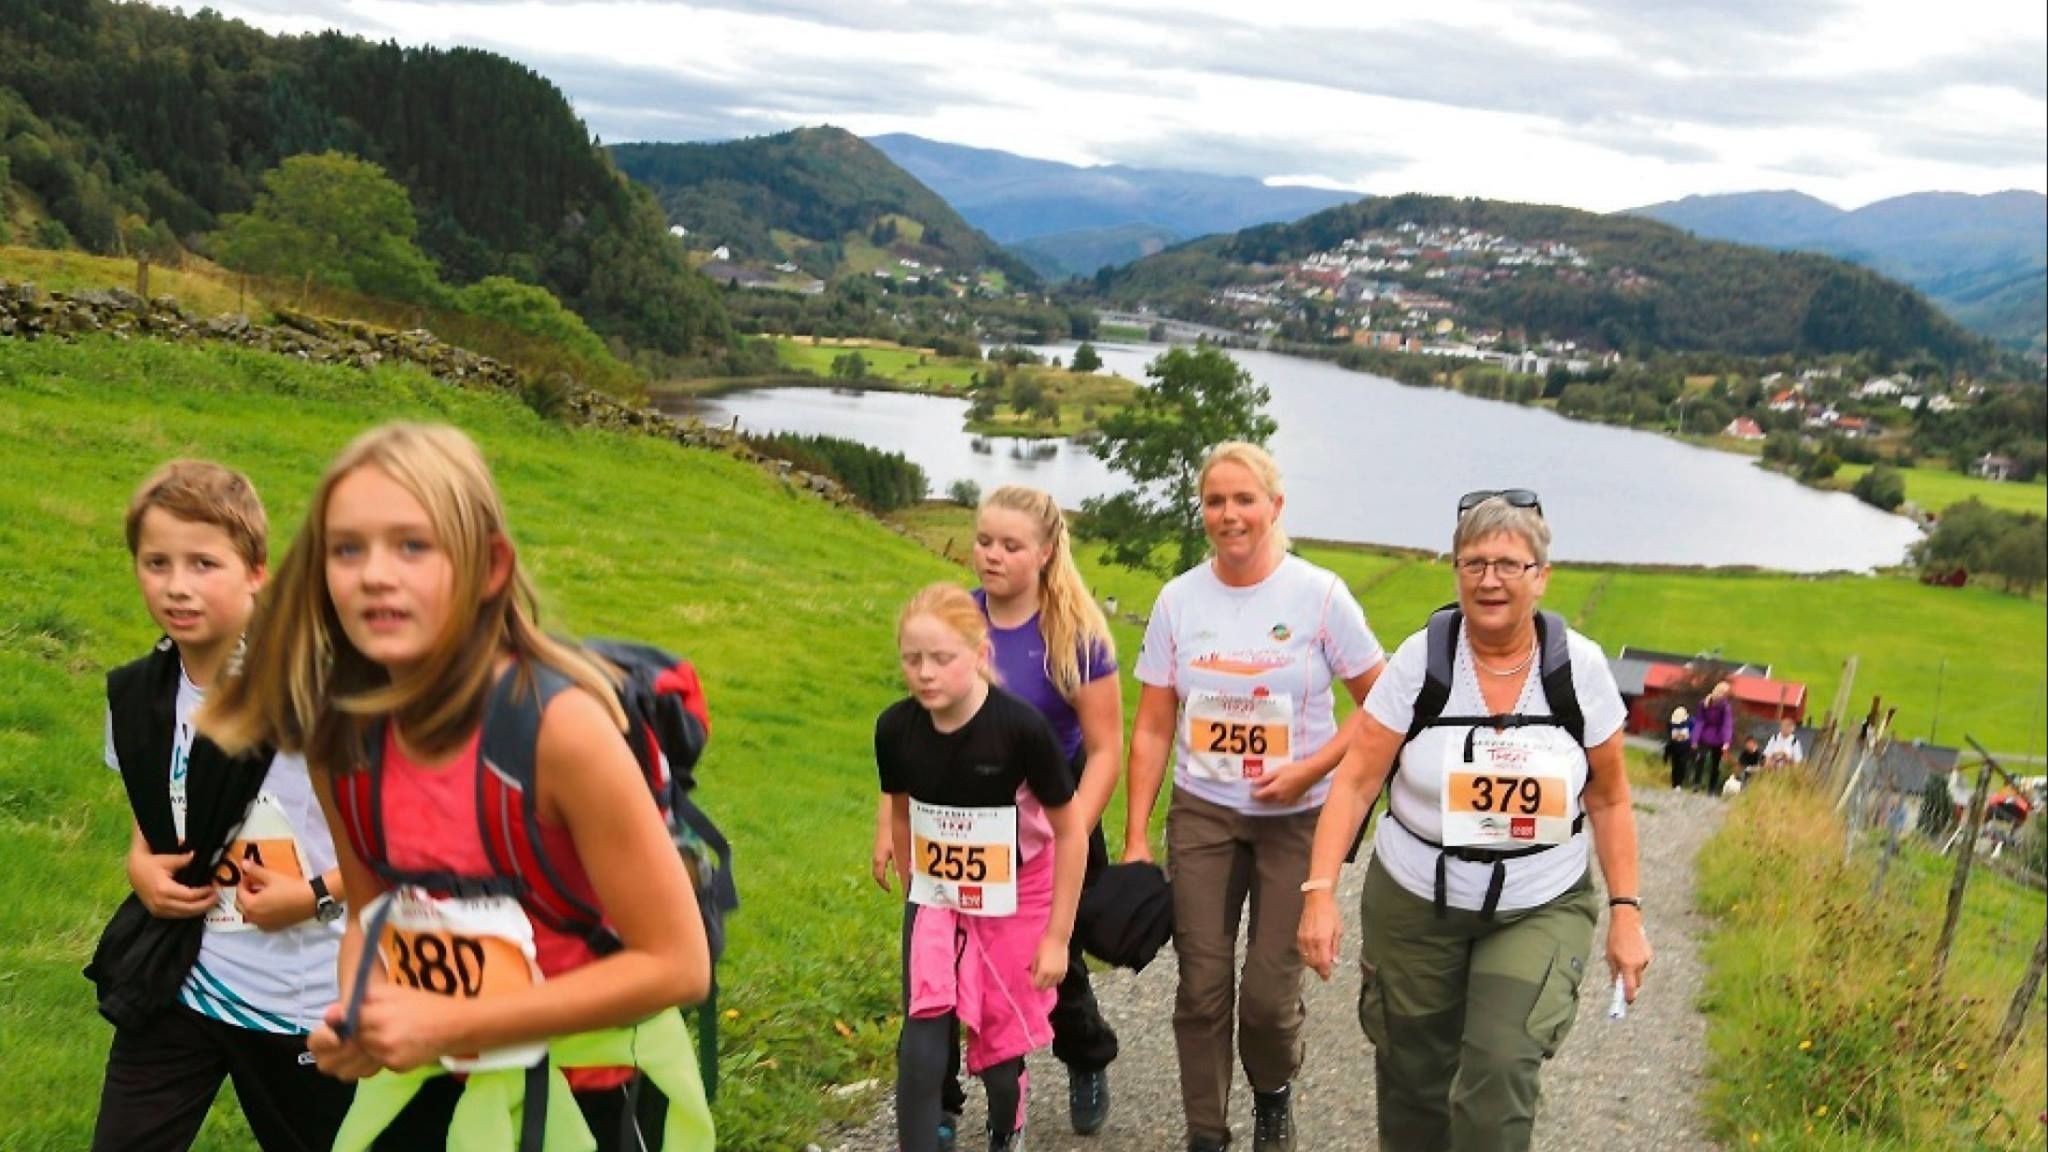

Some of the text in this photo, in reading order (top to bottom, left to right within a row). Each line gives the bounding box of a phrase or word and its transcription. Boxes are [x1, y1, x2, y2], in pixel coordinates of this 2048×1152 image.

[1209, 721, 1268, 755] 256
[1471, 776, 1542, 815] 379
[927, 841, 987, 882] 255
